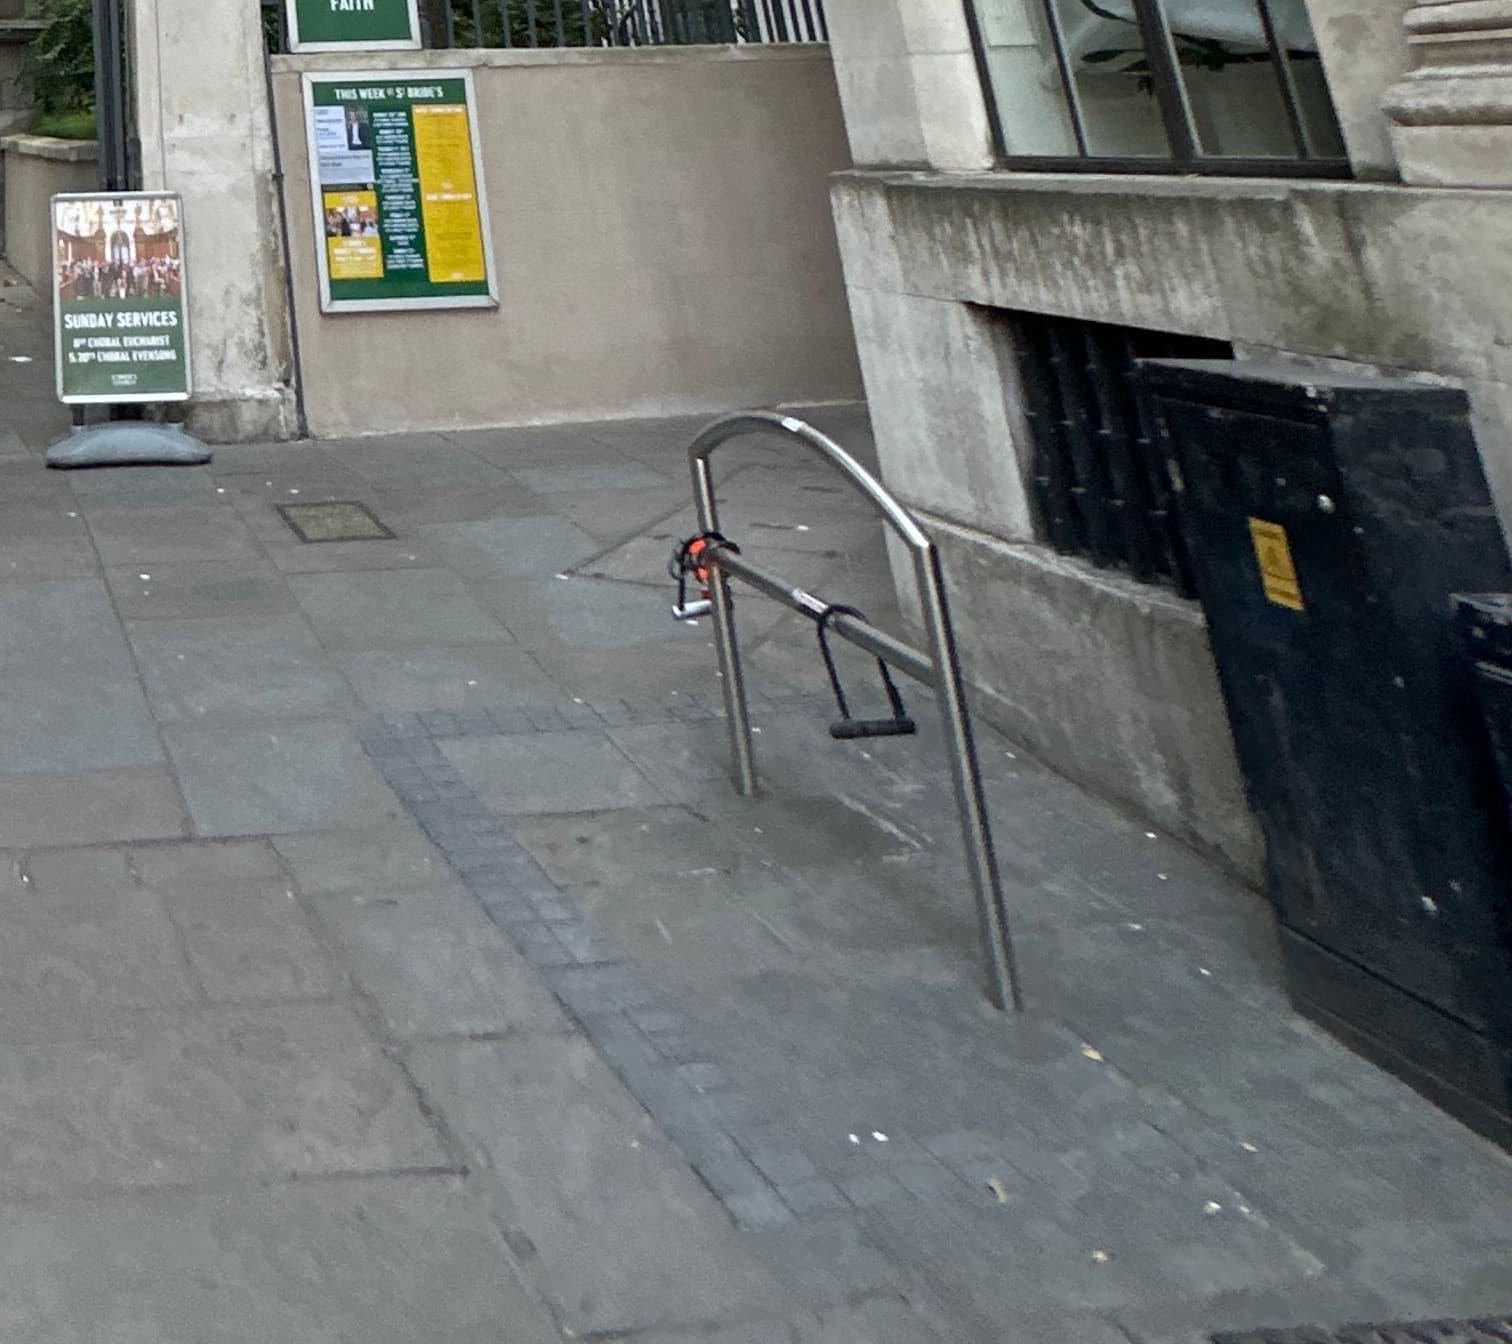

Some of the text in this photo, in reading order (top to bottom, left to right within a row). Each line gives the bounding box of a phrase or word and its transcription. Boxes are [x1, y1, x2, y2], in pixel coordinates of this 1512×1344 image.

[334, 88, 358, 100] THIS
[359, 87, 386, 100] WEEK
[64, 311, 178, 329] SUNDAY SERVICES
